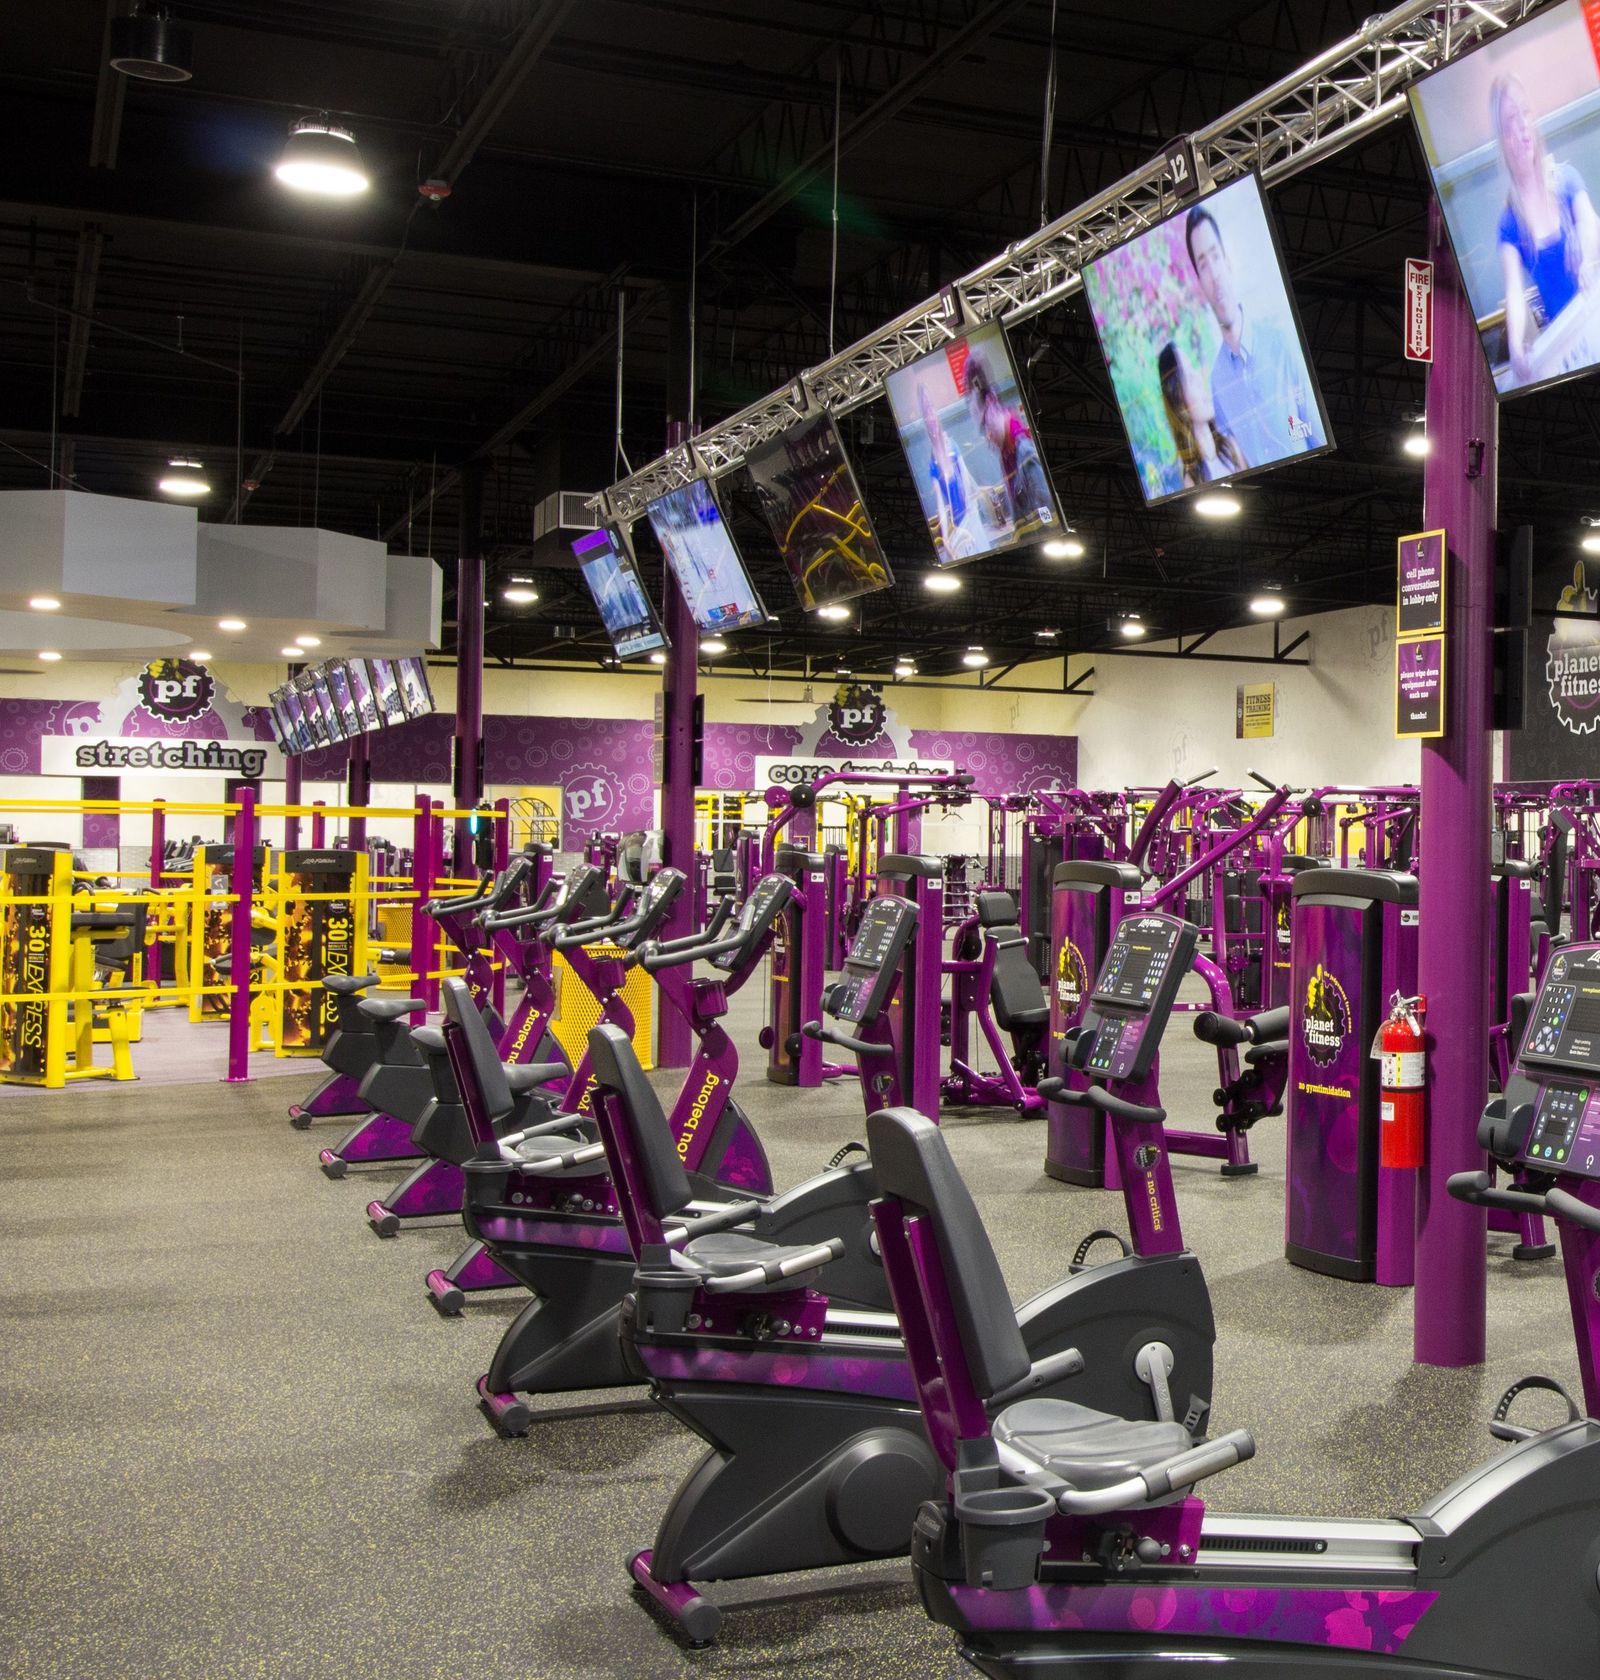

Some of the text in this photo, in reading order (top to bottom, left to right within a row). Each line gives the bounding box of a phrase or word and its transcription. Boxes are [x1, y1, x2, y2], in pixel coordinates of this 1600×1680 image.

[1169, 153, 1189, 184] 12
[1410, 272, 1430, 285] FIRE
[1401, 579, 1440, 592] conversations
[1406, 567, 1435, 580] cell phone
[1402, 591, 1438, 606] in lobby only
[153, 674, 202, 704] pf
[1246, 693, 1271, 705] FITNESS
[840, 703, 875, 728] pf
[1246, 704, 1271, 713] TRAINING
[76, 740, 266, 778] stretching
[566, 778, 607, 819] pf
[28, 925, 46, 952] 30
[328, 917, 348, 942] 30
[25, 964, 45, 1048] EXRESS
[512, 1007, 540, 1050] belong
[1305, 1016, 1334, 1032] planet
[1308, 1030, 1340, 1047] fitness
[683, 1072, 720, 1130] belong
[1298, 1082, 1351, 1098] no gymtimidation
[1147, 1180, 1161, 1231] no critics
